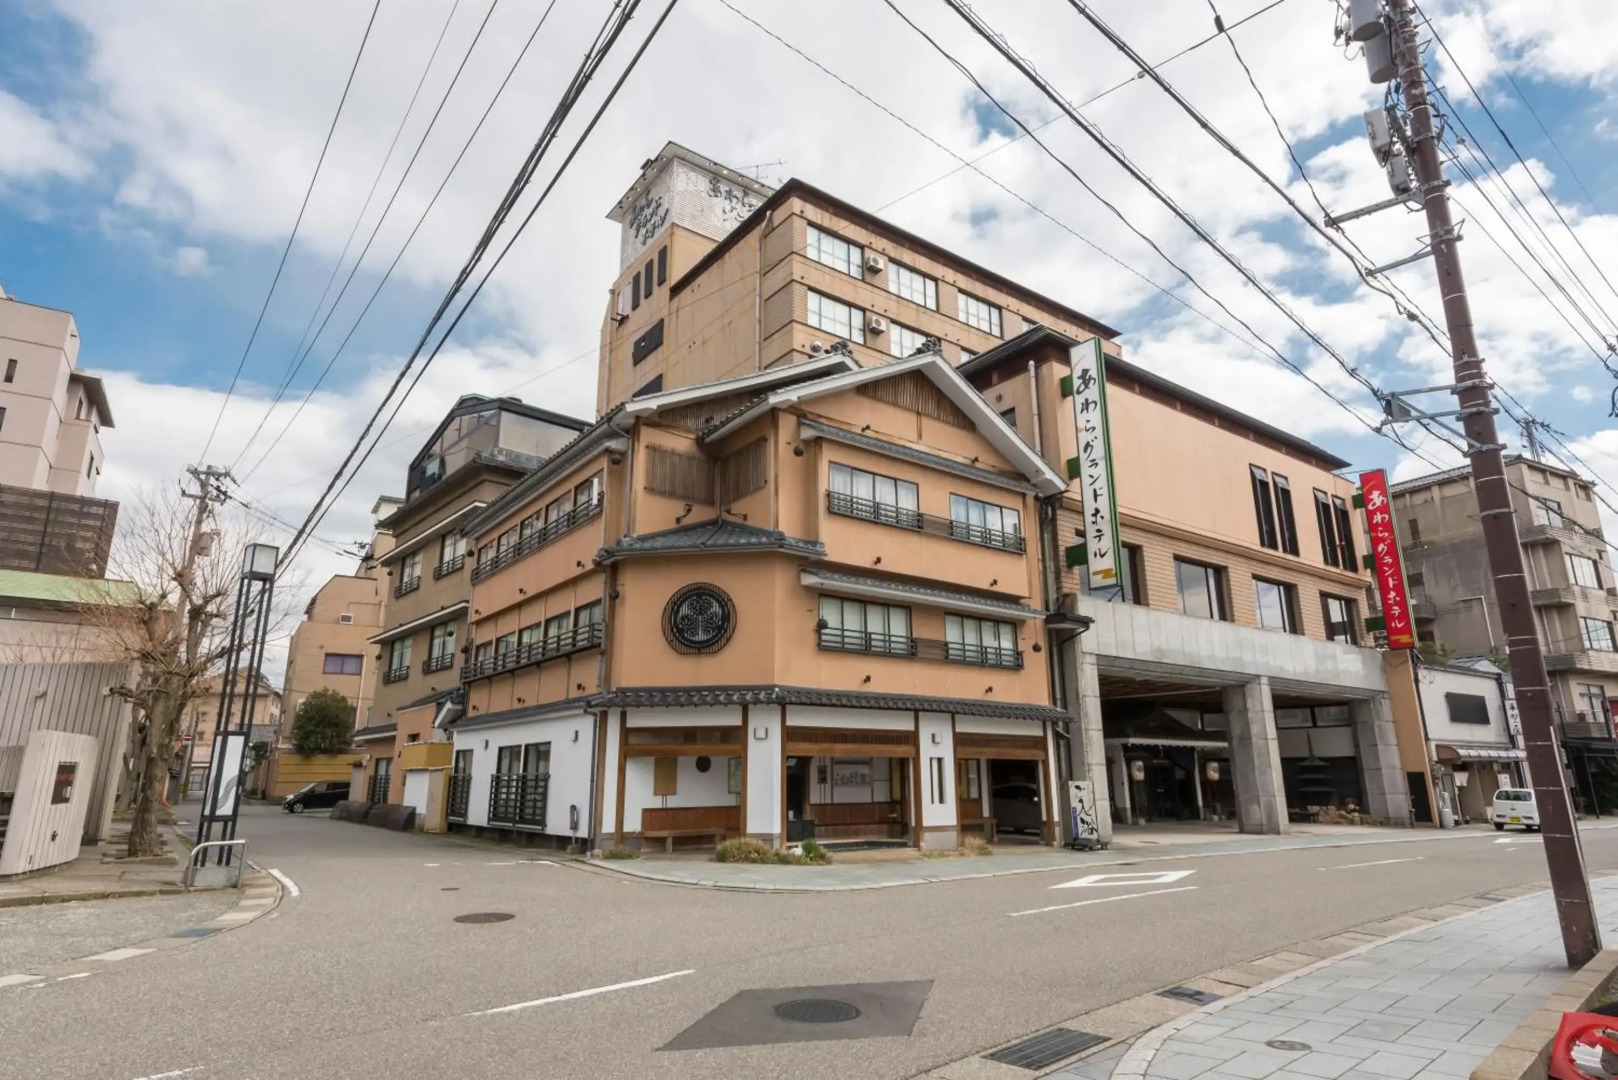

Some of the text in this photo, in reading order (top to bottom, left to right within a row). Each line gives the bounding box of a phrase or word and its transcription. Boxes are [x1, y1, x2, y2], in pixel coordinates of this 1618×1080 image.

[1075, 368, 1111, 559] あわらグランドホテル
[1367, 490, 1406, 629] あわらグランドホテル
